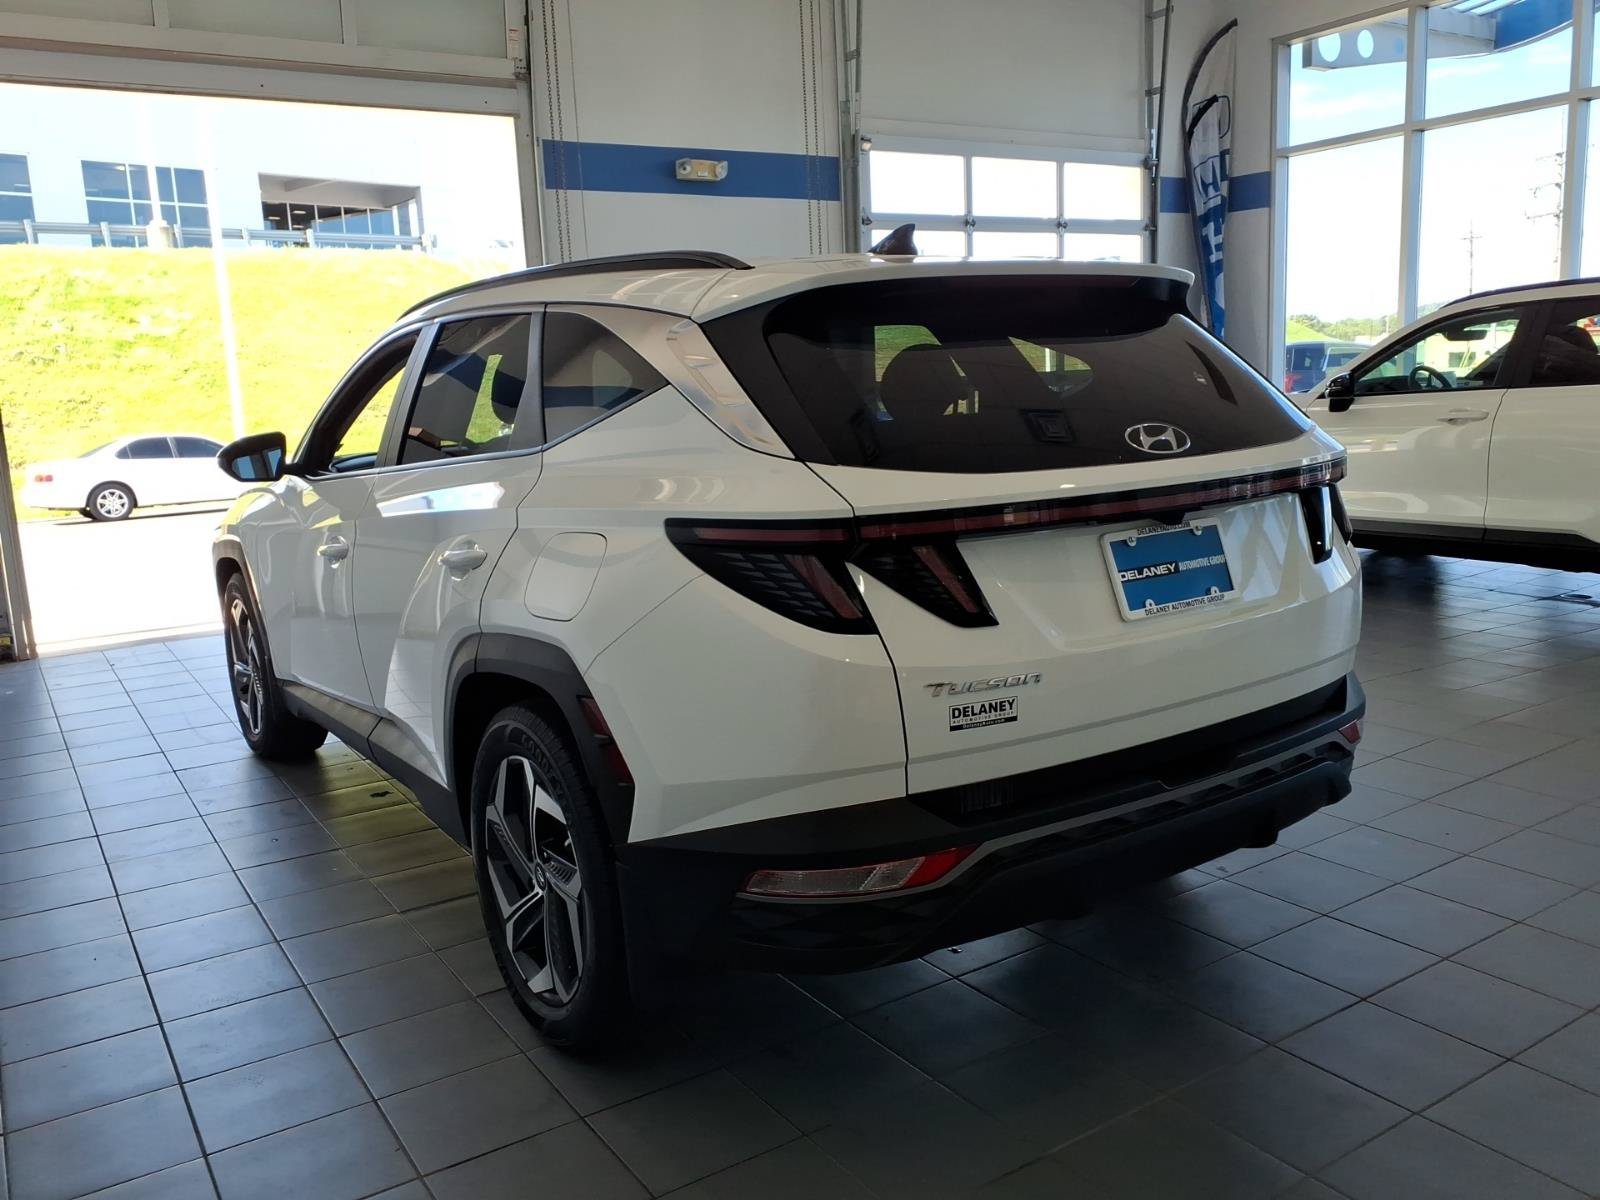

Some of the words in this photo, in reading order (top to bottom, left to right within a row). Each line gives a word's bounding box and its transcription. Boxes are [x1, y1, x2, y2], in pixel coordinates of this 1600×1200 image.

[1119, 563, 1176, 581] DELANEY
[1179, 557, 1210, 571] AUTOMOTIVE
[1145, 606, 1170, 616] DELANEY
[1172, 597, 1206, 611] AUTOMOTIVE
[1207, 593, 1225, 605] GROUP
[952, 698, 1016, 719] DELANEY
[952, 714, 992, 725] AUTOMOTIVE
